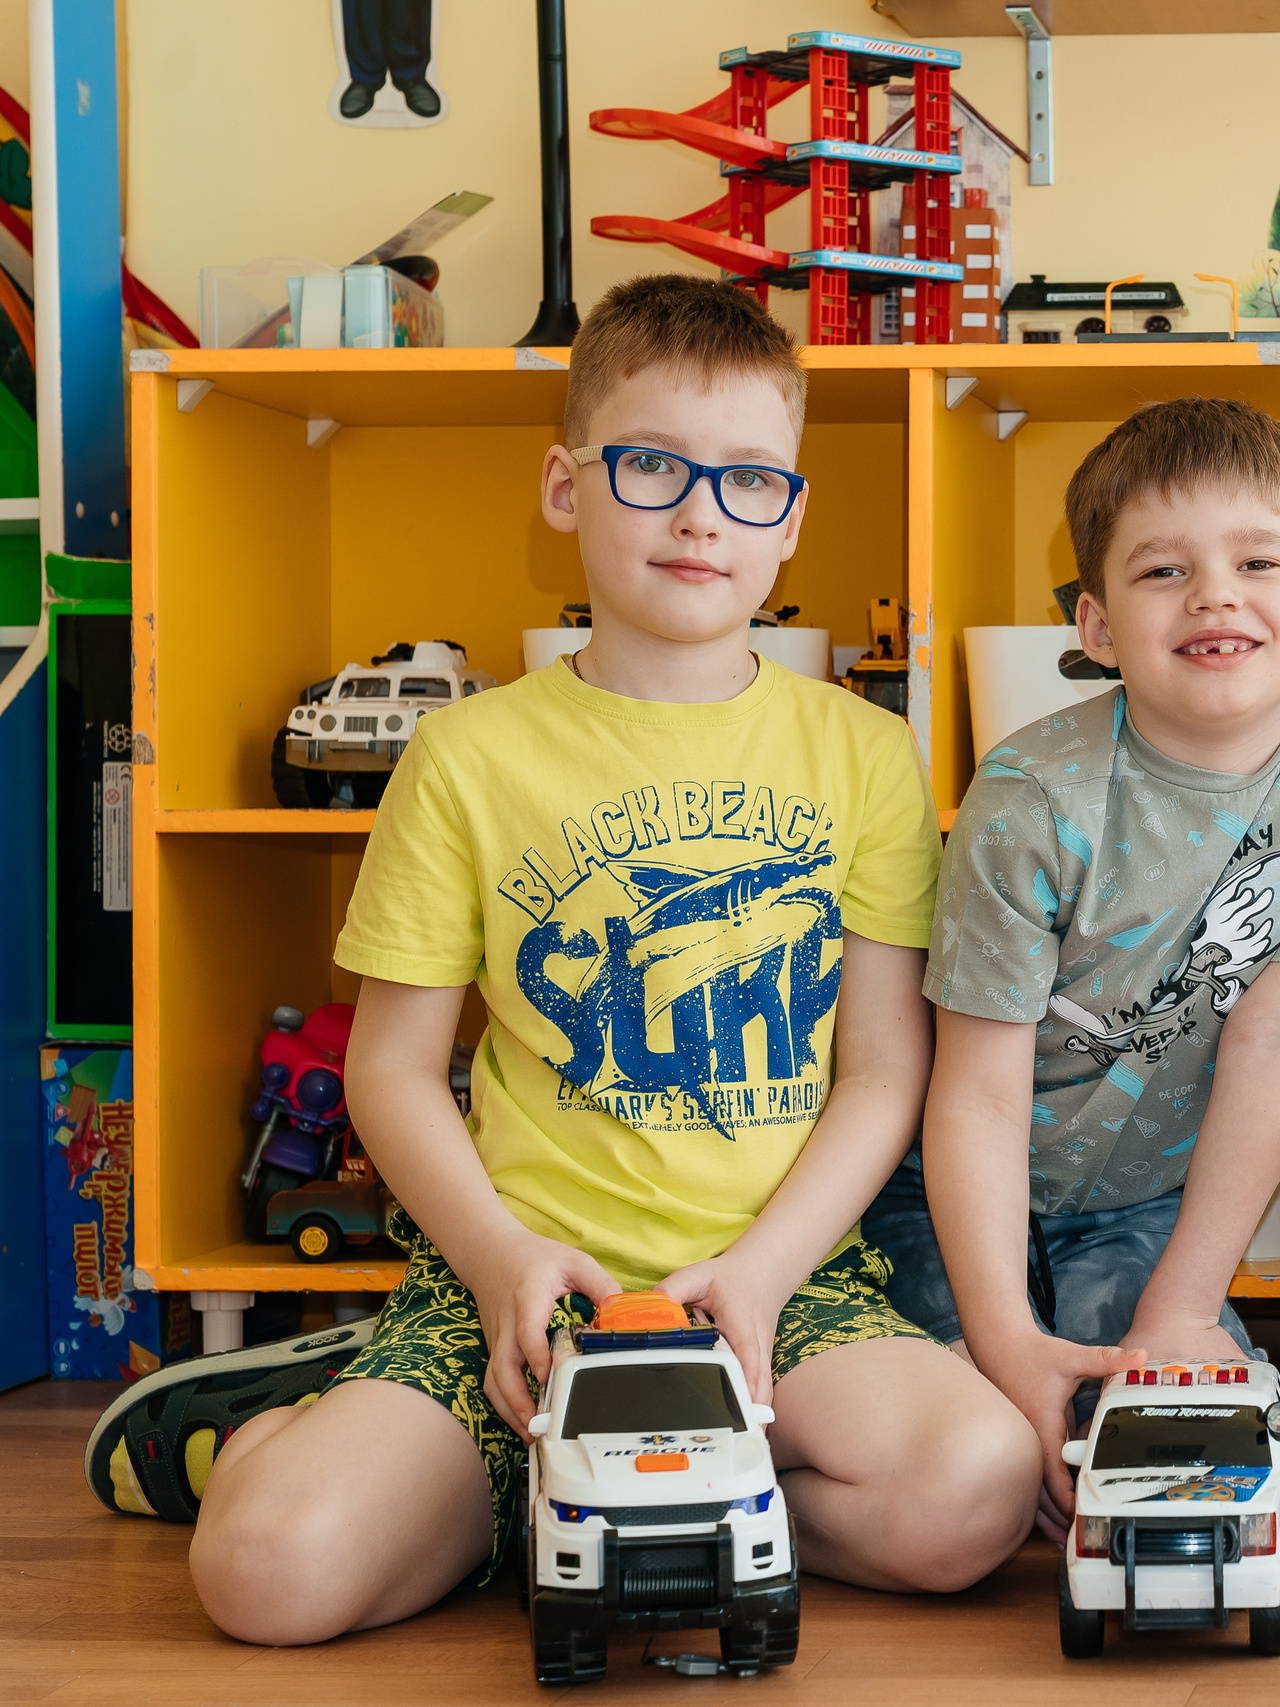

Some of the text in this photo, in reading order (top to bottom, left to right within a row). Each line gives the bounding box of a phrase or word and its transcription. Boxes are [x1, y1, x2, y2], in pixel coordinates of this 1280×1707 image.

[497, 784, 672, 927] BLACK
[1158, 1088, 1172, 1101] BE
[684, 1121, 713, 1131] GOOD
[1140, 1407, 1240, 1418] ROAD RIPPERS
[602, 1446, 718, 1458] RESCUE
